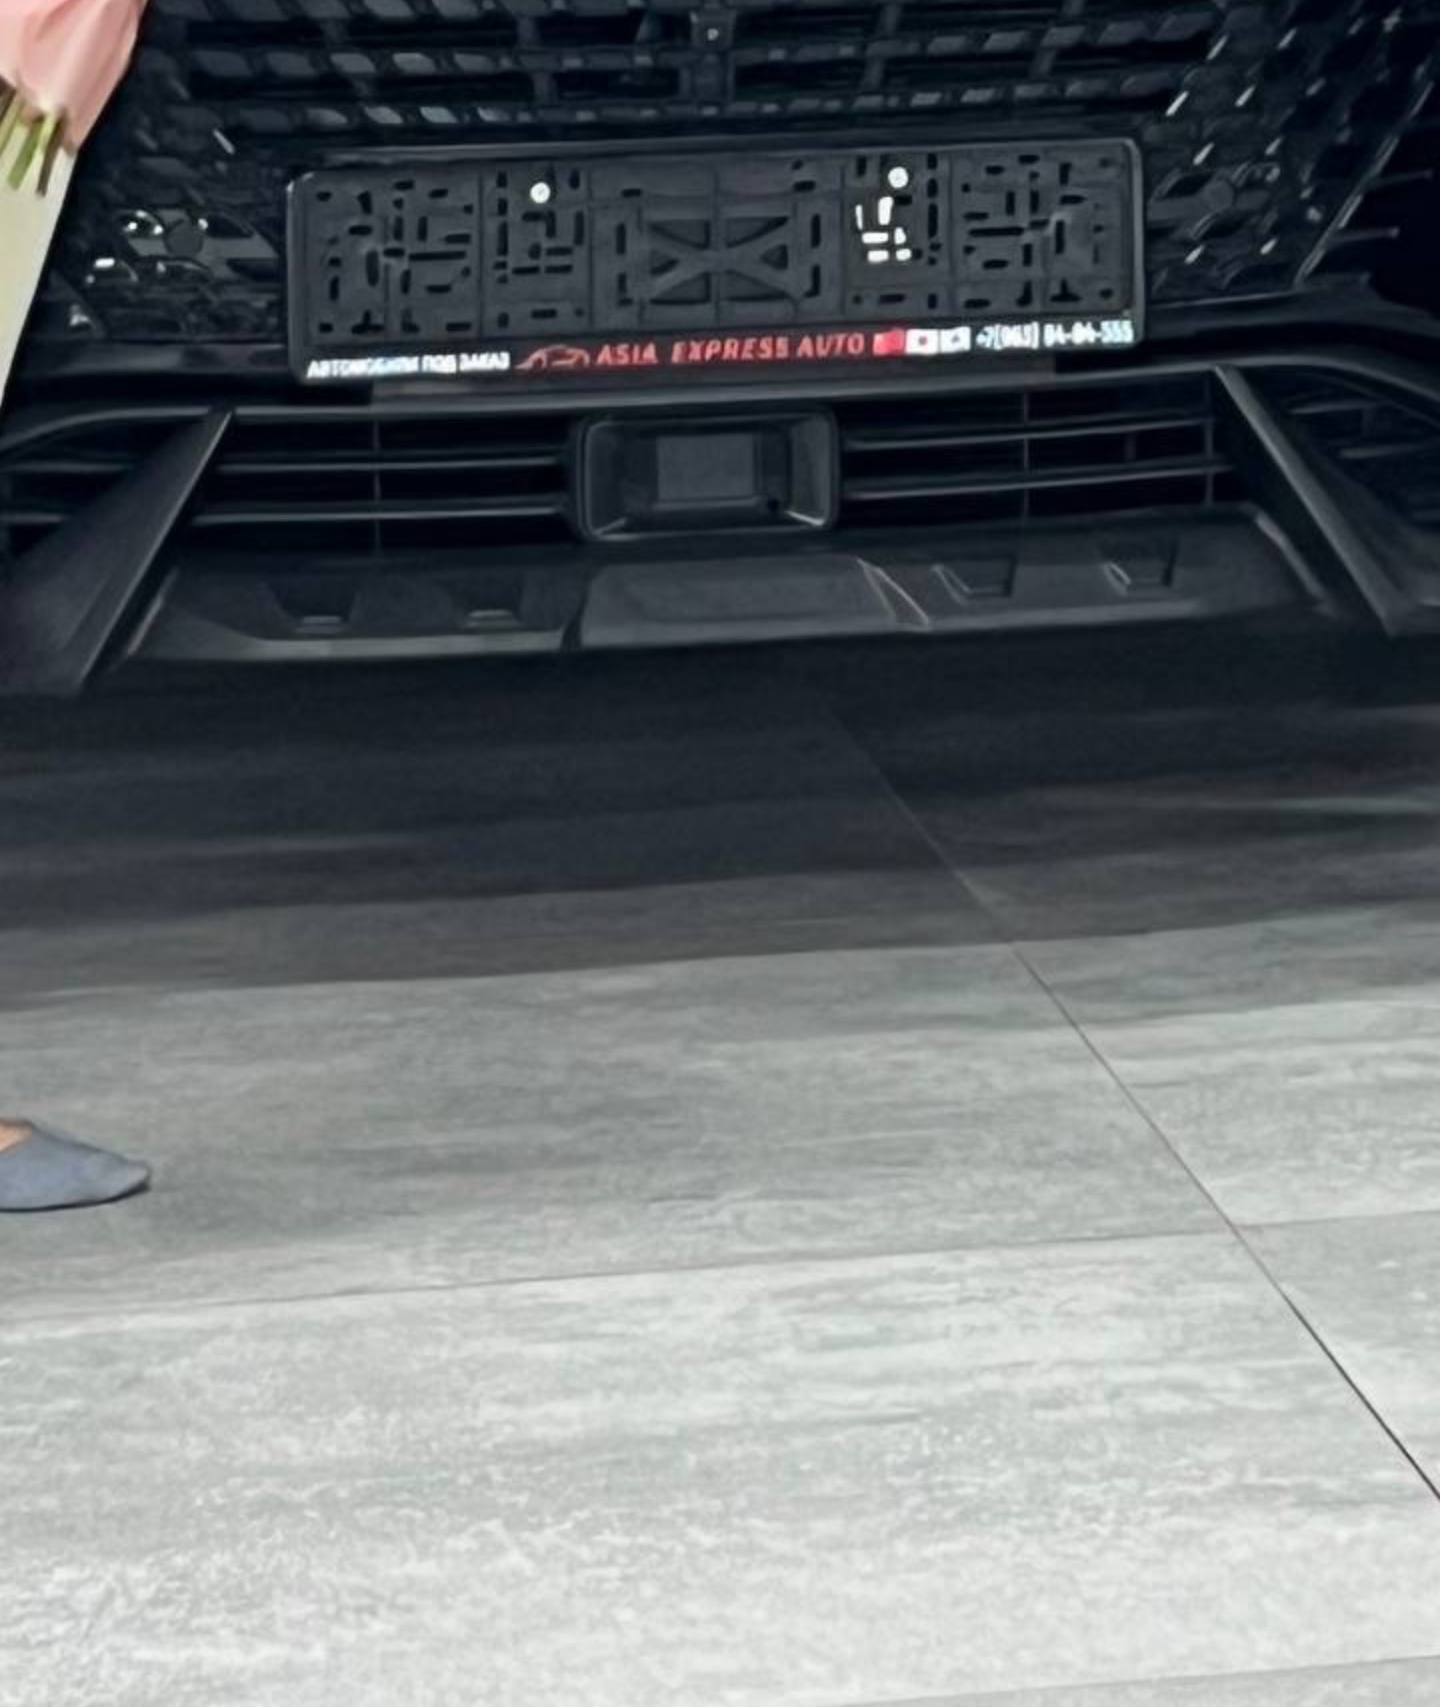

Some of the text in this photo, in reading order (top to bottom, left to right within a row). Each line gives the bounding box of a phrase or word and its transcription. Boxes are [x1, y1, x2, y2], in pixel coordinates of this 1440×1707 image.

[596, 332, 865, 366] ASIA EXPRESS AUTO
